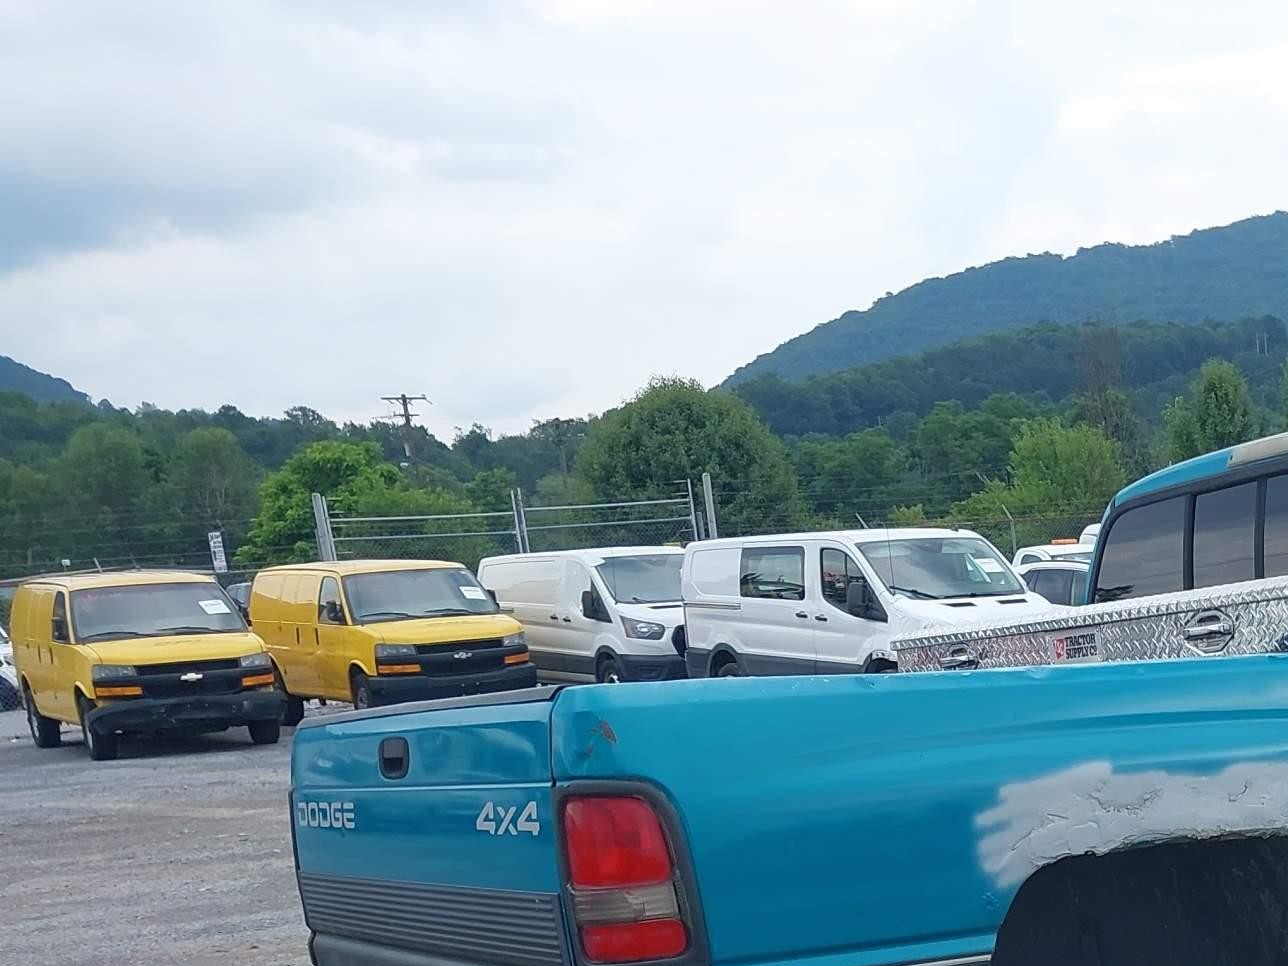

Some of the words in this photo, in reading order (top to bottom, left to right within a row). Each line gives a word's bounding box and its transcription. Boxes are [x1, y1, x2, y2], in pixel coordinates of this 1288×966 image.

[1064, 633, 1096, 648] TRACTOR
[1066, 646, 1089, 660] SUPPLY
[298, 801, 355, 829] DODGE
